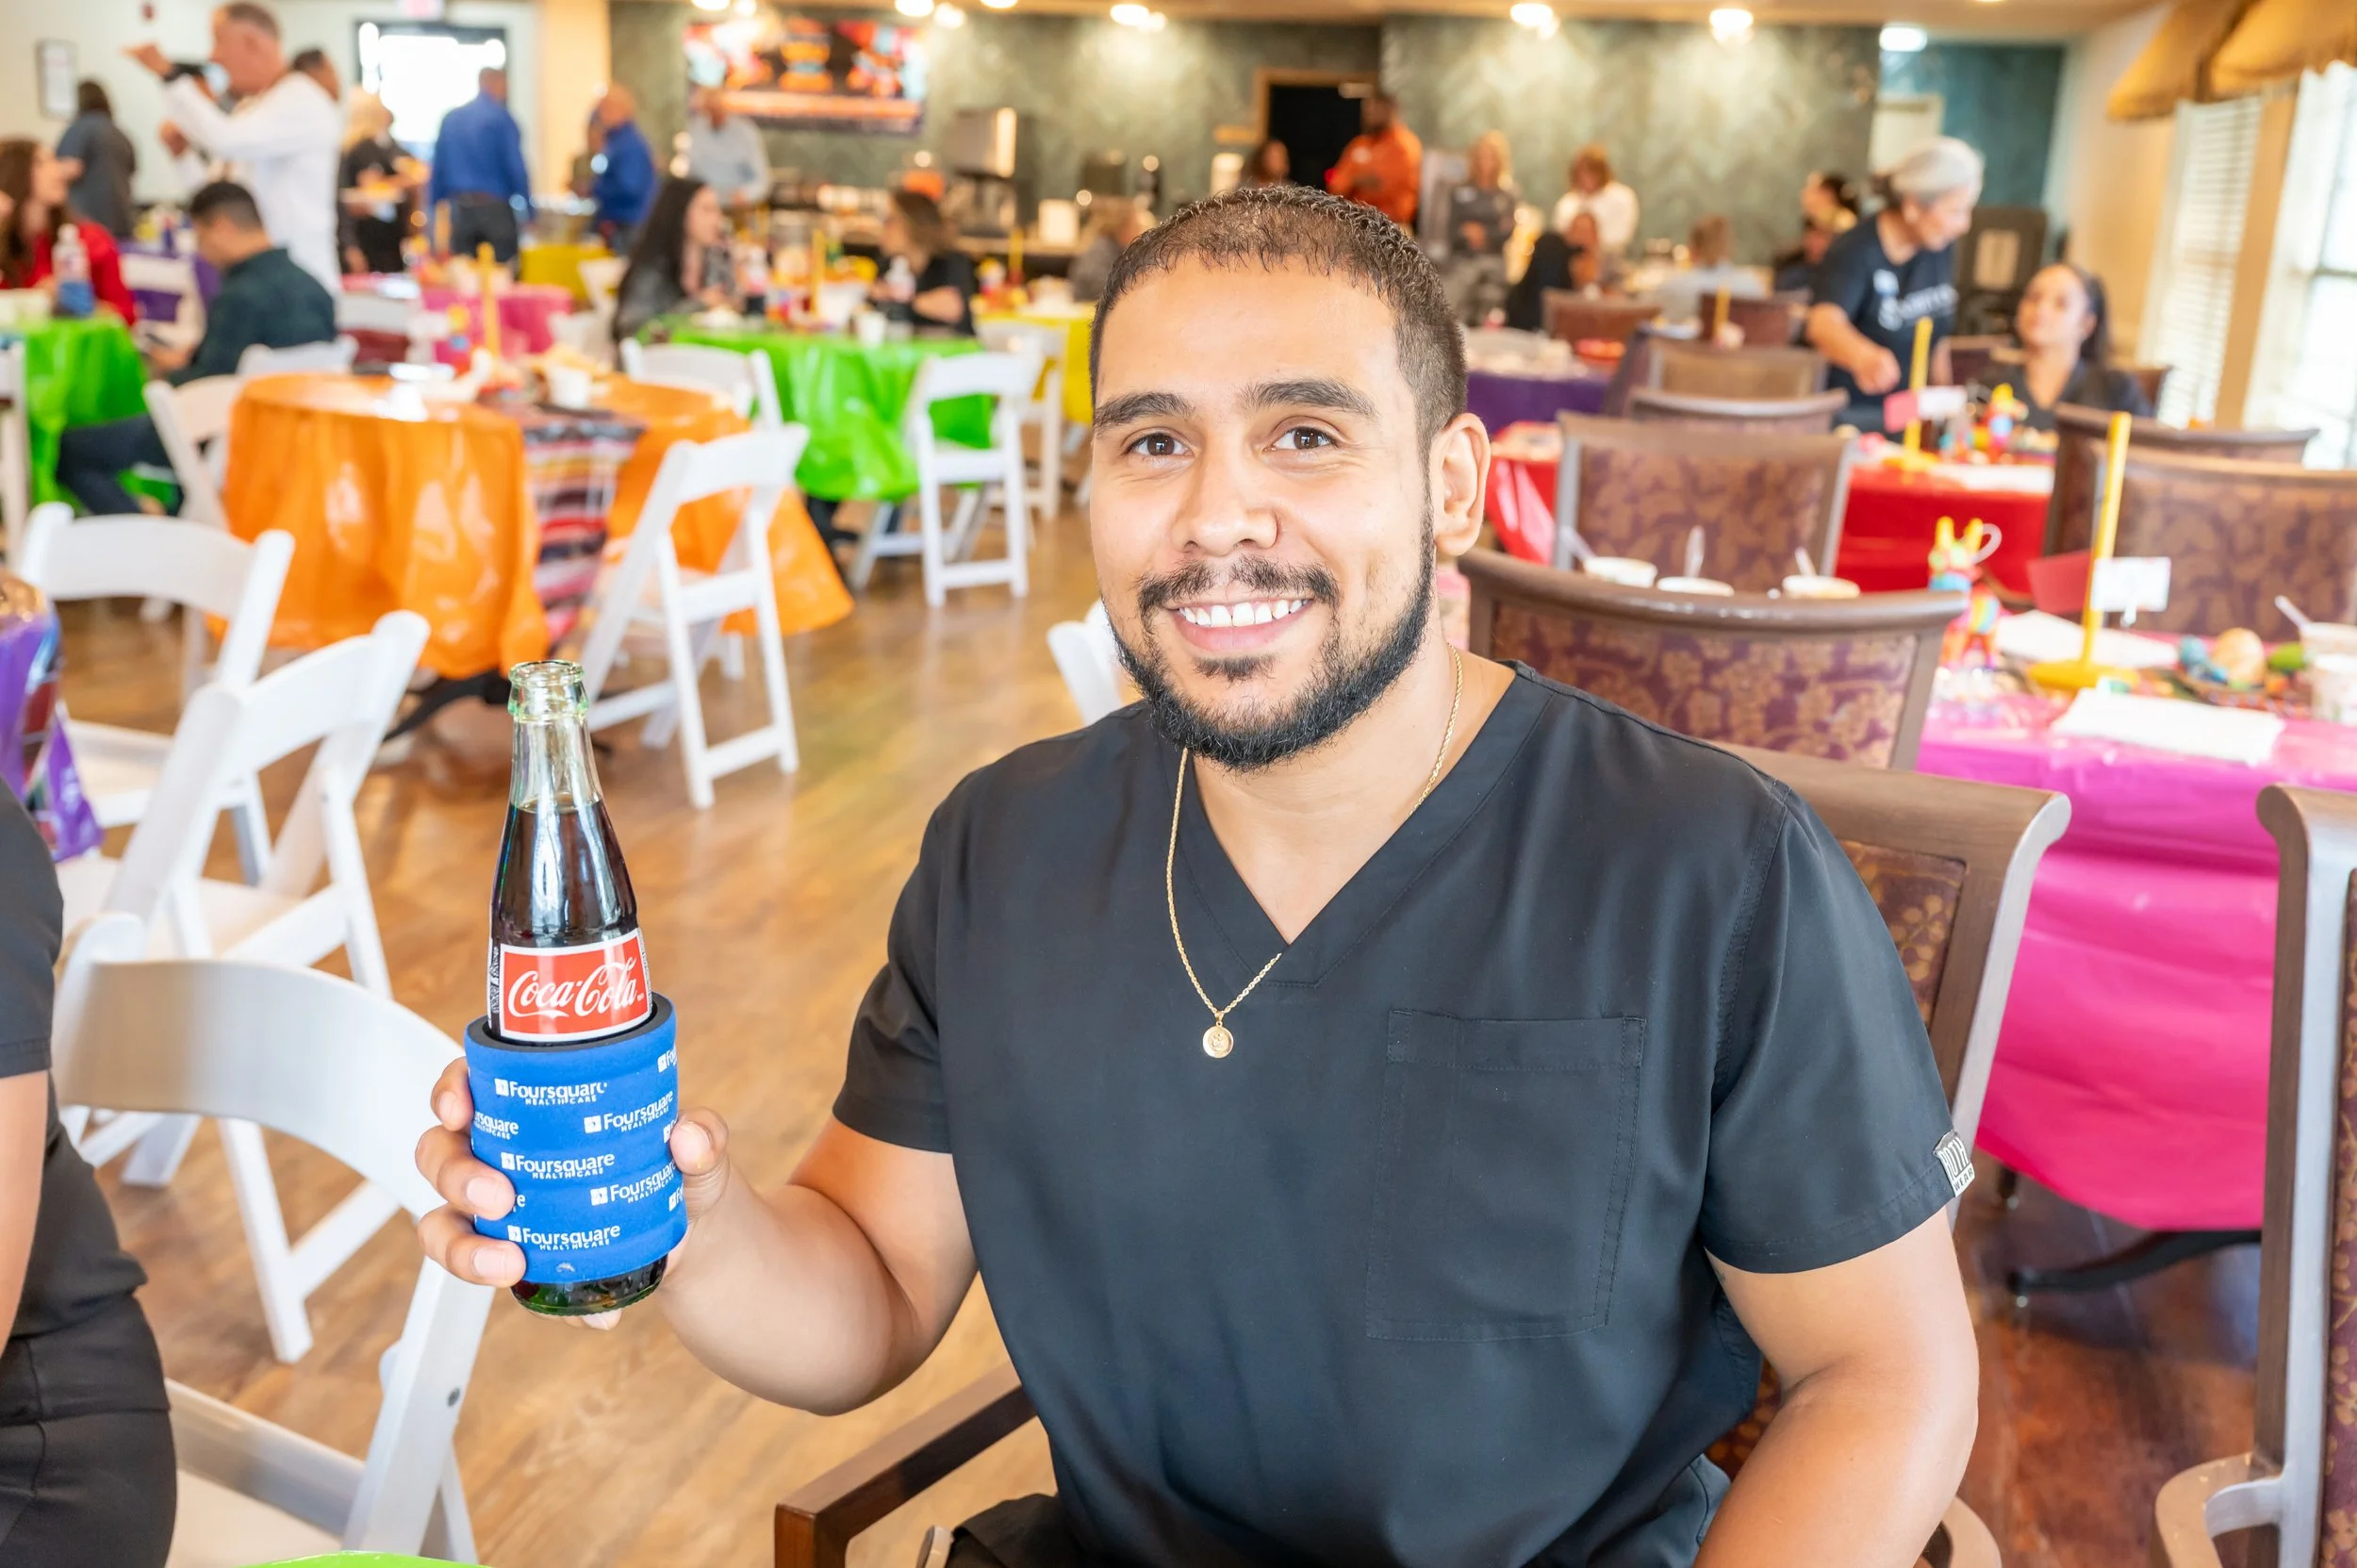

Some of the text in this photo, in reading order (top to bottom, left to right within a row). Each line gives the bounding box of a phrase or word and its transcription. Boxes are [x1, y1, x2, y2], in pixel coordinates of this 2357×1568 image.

[508, 956, 636, 1019] Coca-Cola
[603, 1090, 673, 1131] Foursquare
[516, 1153, 616, 1178] Foursquare
[1953, 1167, 1974, 1192] WEAR
[522, 1225, 621, 1248] Foursquare
